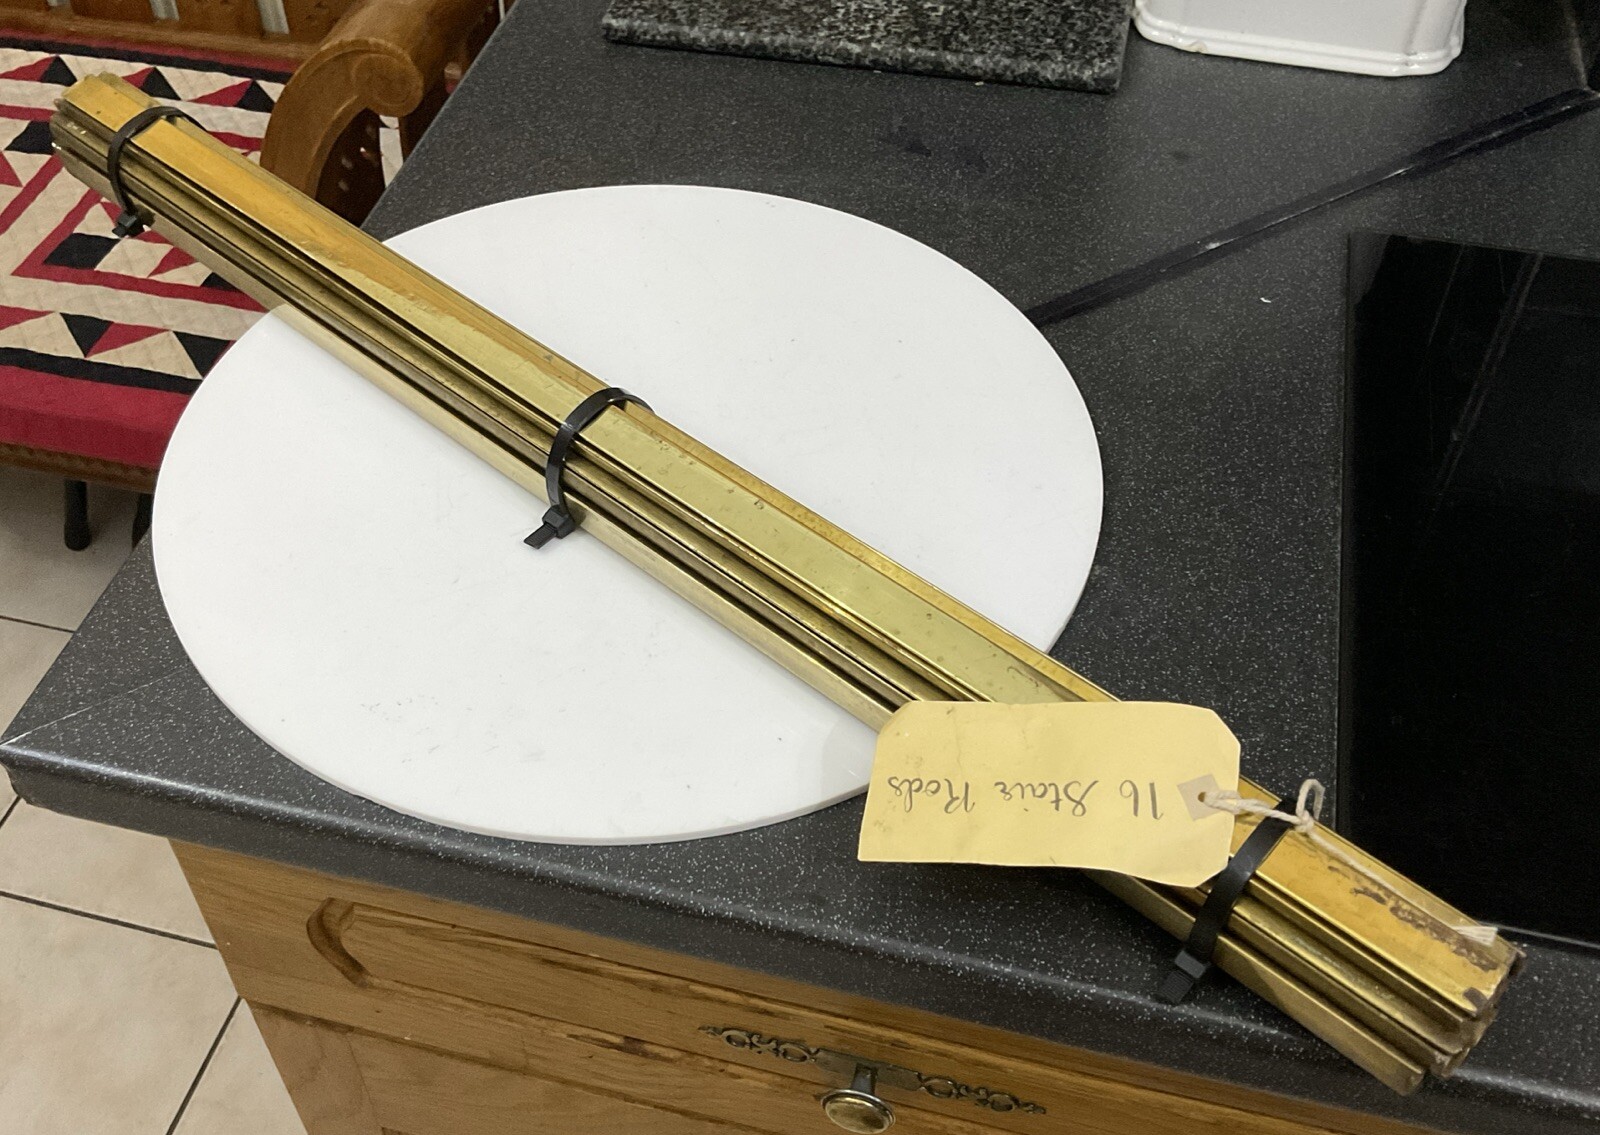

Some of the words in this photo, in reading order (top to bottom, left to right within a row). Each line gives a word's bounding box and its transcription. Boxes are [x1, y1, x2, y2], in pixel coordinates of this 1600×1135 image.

[887, 776, 976, 814] Rods
[994, 780, 1099, 817] Stair
[1120, 779, 1163, 820] 16
